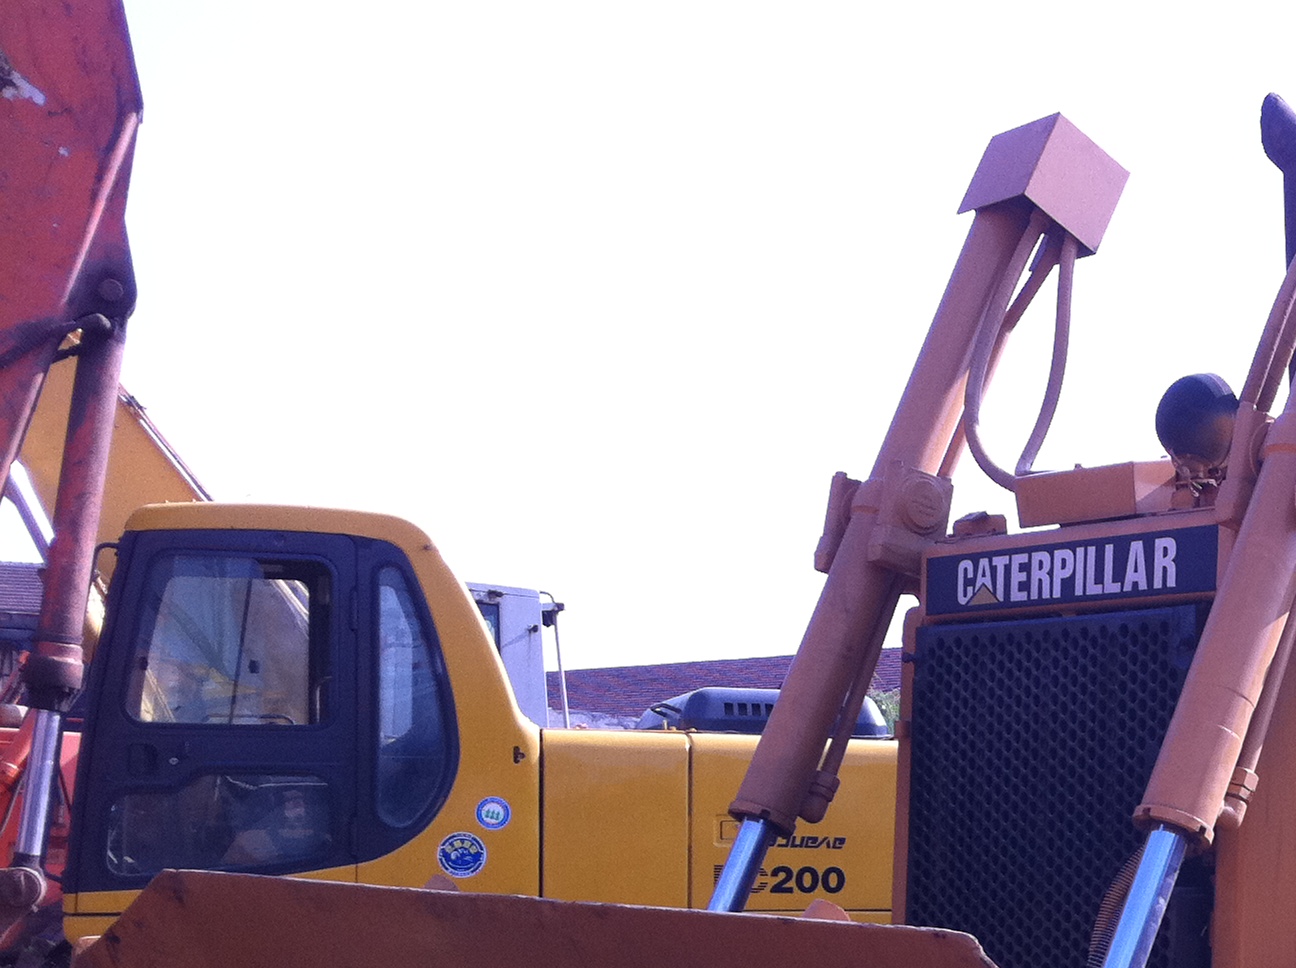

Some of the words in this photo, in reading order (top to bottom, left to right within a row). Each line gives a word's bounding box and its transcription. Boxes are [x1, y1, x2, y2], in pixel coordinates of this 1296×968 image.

[957, 537, 1177, 605] CATERPILLAR
[768, 835, 847, 849] avanc
[714, 864, 846, 894] C200
